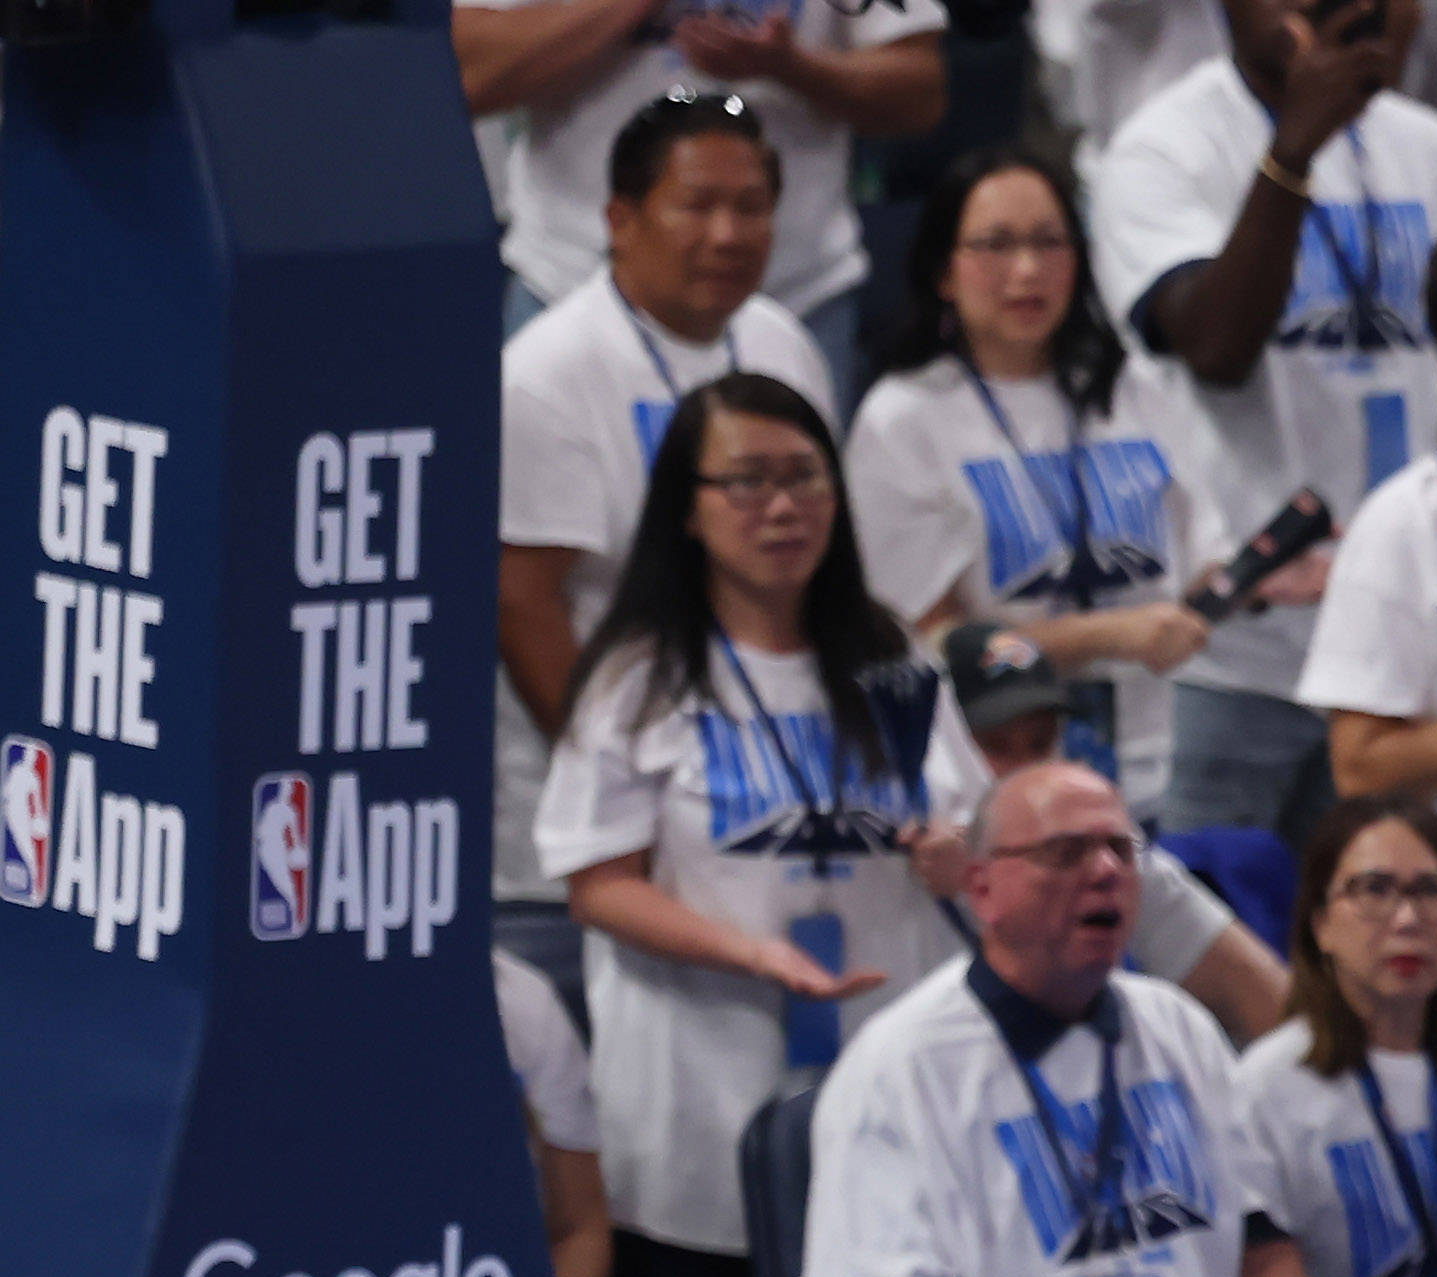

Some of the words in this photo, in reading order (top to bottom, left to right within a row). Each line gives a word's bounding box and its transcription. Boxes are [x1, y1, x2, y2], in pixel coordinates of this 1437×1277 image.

[38, 405, 169, 580] GET
[293, 428, 435, 589] GET
[35, 571, 163, 750] THE
[289, 597, 431, 755] THE
[51, 751, 186, 961] App
[317, 773, 459, 962] App
